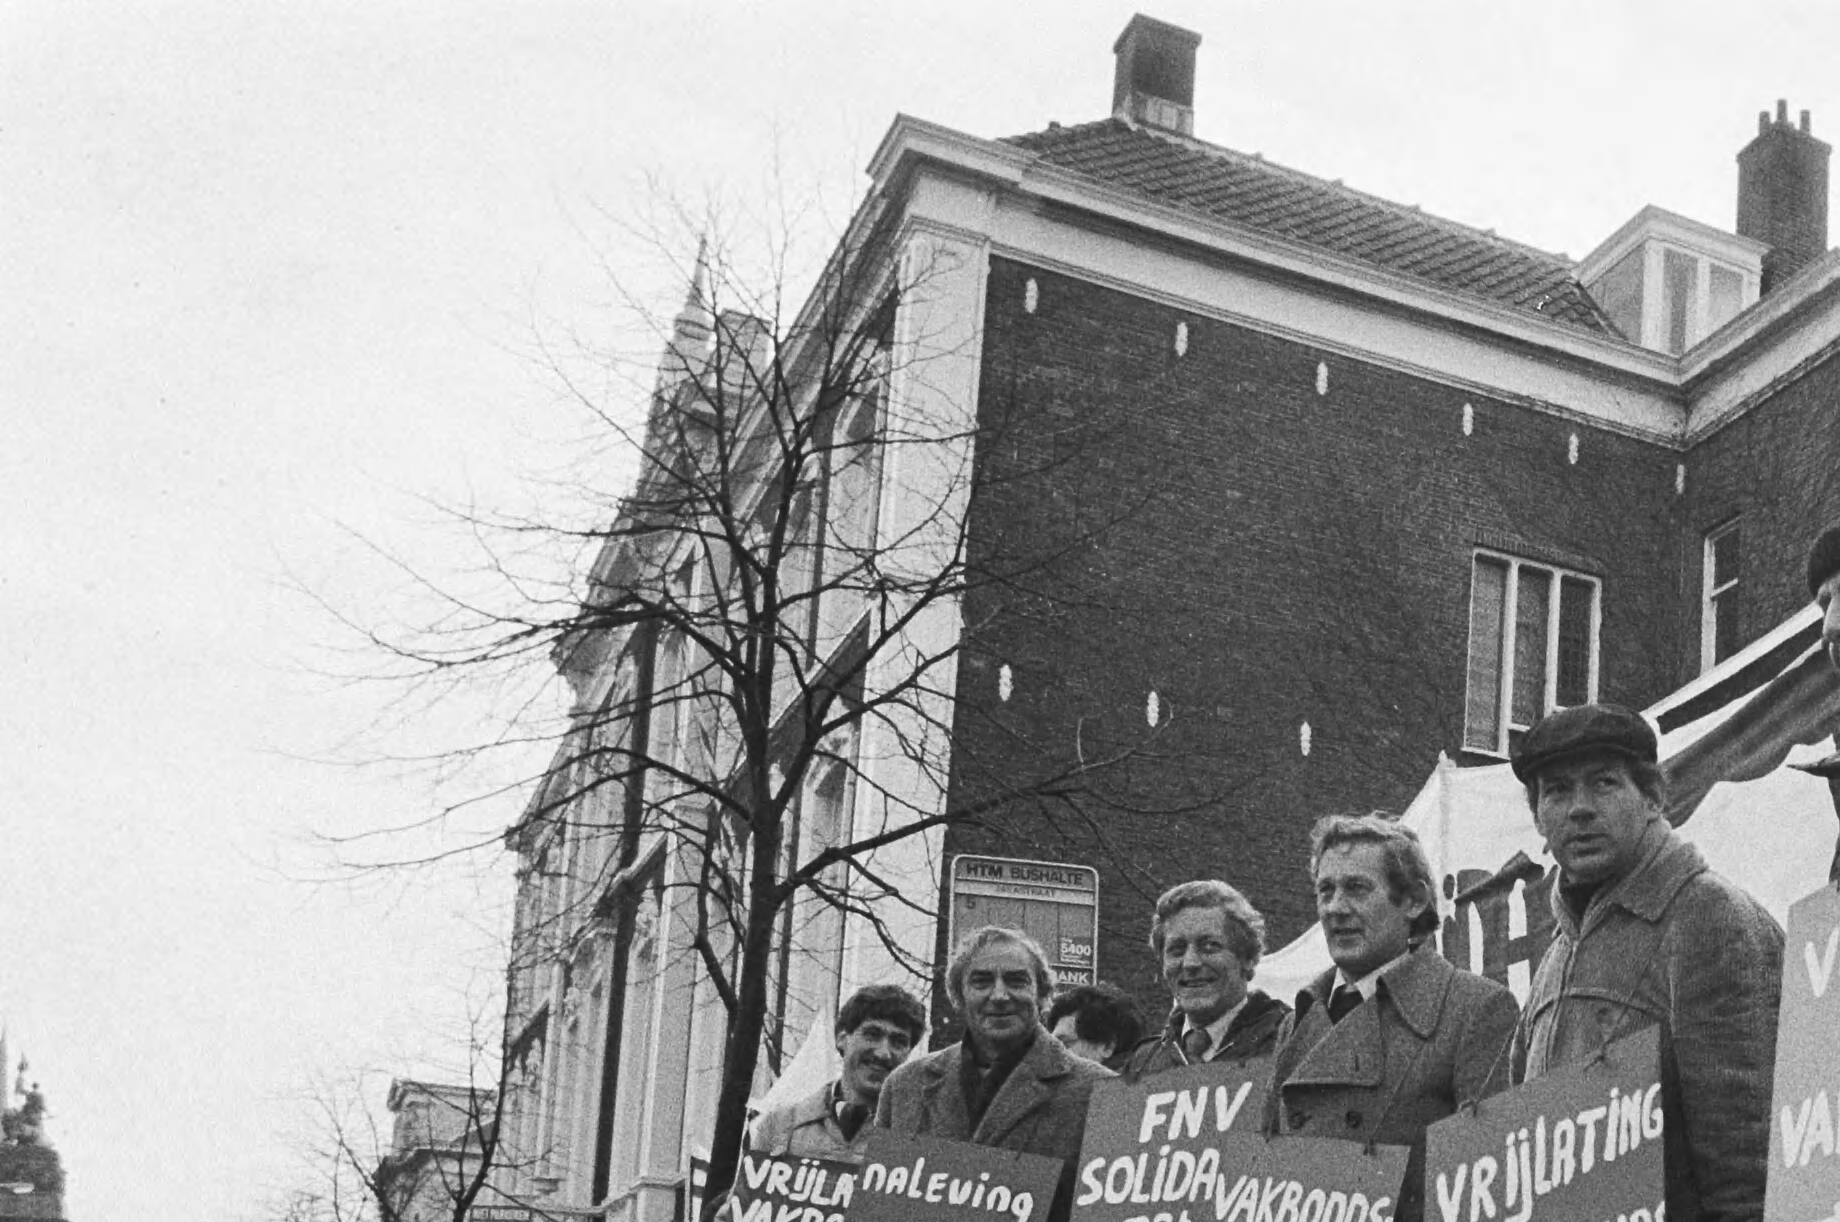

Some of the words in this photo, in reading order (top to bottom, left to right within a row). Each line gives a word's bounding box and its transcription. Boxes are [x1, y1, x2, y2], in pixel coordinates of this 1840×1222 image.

[966, 863, 1003, 879] HTM
[1011, 867, 1083, 885] BUSHALTE
[1056, 971, 1090, 984] ANK
[1139, 1081, 1253, 1143] FNV
